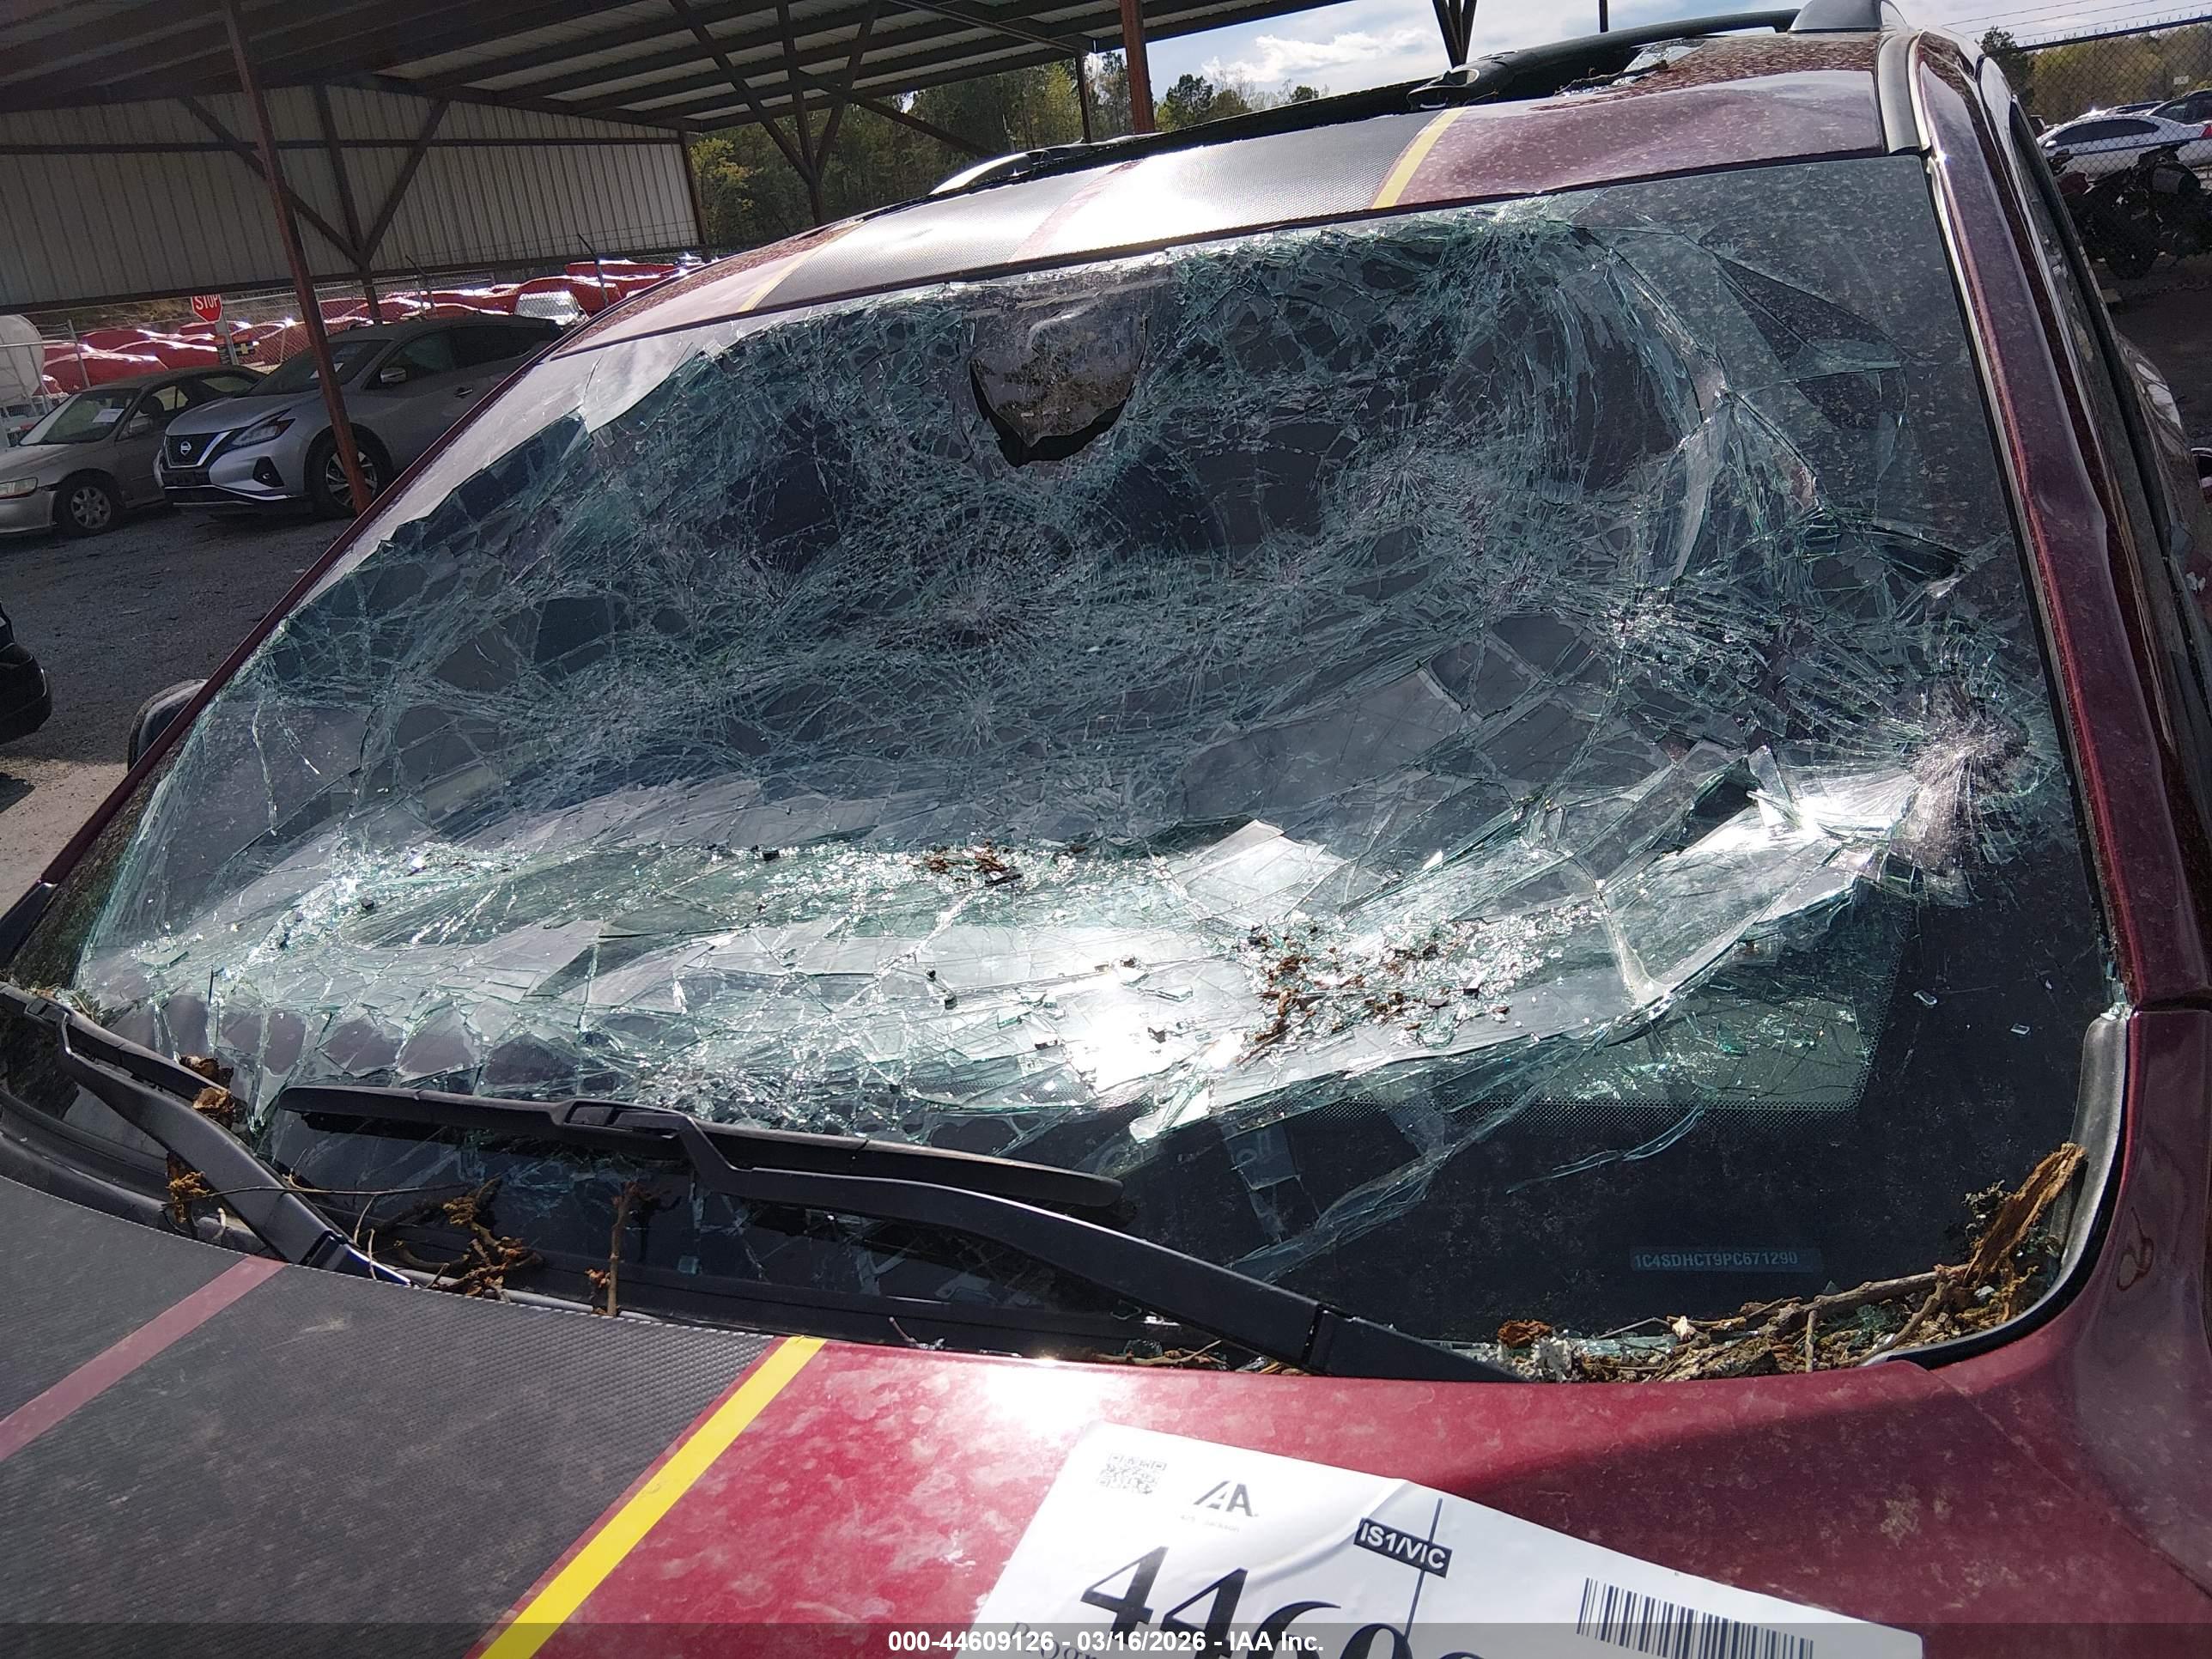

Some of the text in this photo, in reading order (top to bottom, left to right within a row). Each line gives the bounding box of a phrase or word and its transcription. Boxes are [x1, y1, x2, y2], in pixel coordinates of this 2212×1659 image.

[194, 295, 218, 310] STOP
[1635, 1251, 1798, 1267] 1C4SDHCT9PC671290
[1360, 1522, 1446, 1569] IS1/VIC
